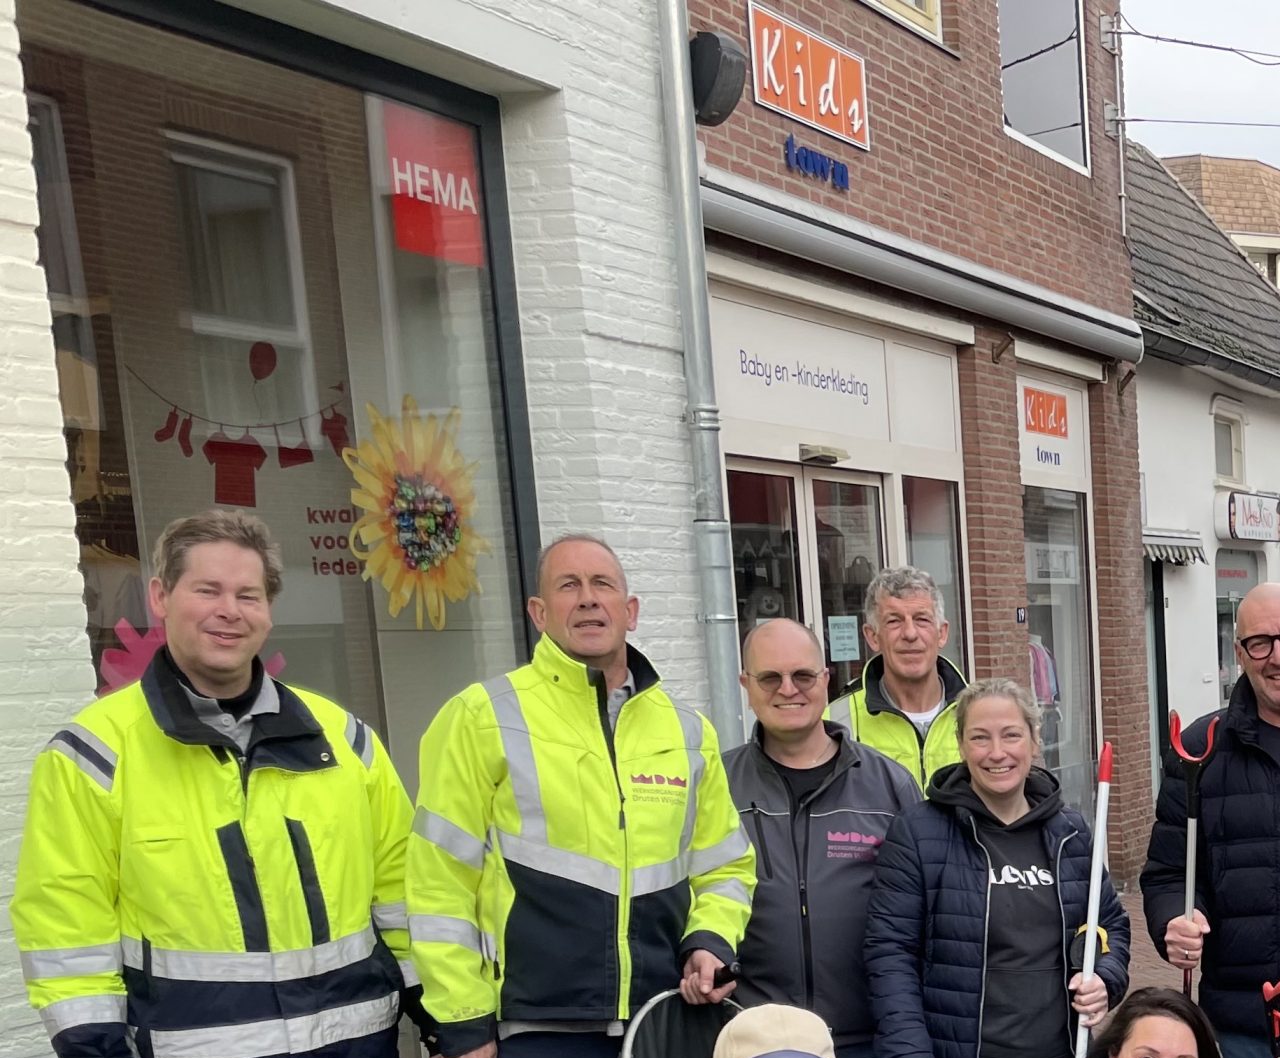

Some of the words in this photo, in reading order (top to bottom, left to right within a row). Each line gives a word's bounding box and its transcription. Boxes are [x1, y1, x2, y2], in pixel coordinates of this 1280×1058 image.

[761, 27, 863, 135] Kids
[784, 132, 850, 191] town
[392, 157, 478, 215] HEMA
[740, 349, 772, 386] Baby
[775, 364, 789, 382] en
[791, 360, 869, 405] -kinderkleding
[1026, 394, 1066, 434] Kids
[1036, 445, 1061, 466] town
[306, 506, 358, 525] kwal
[309, 535, 350, 551] voo
[1018, 608, 1025, 622] 19
